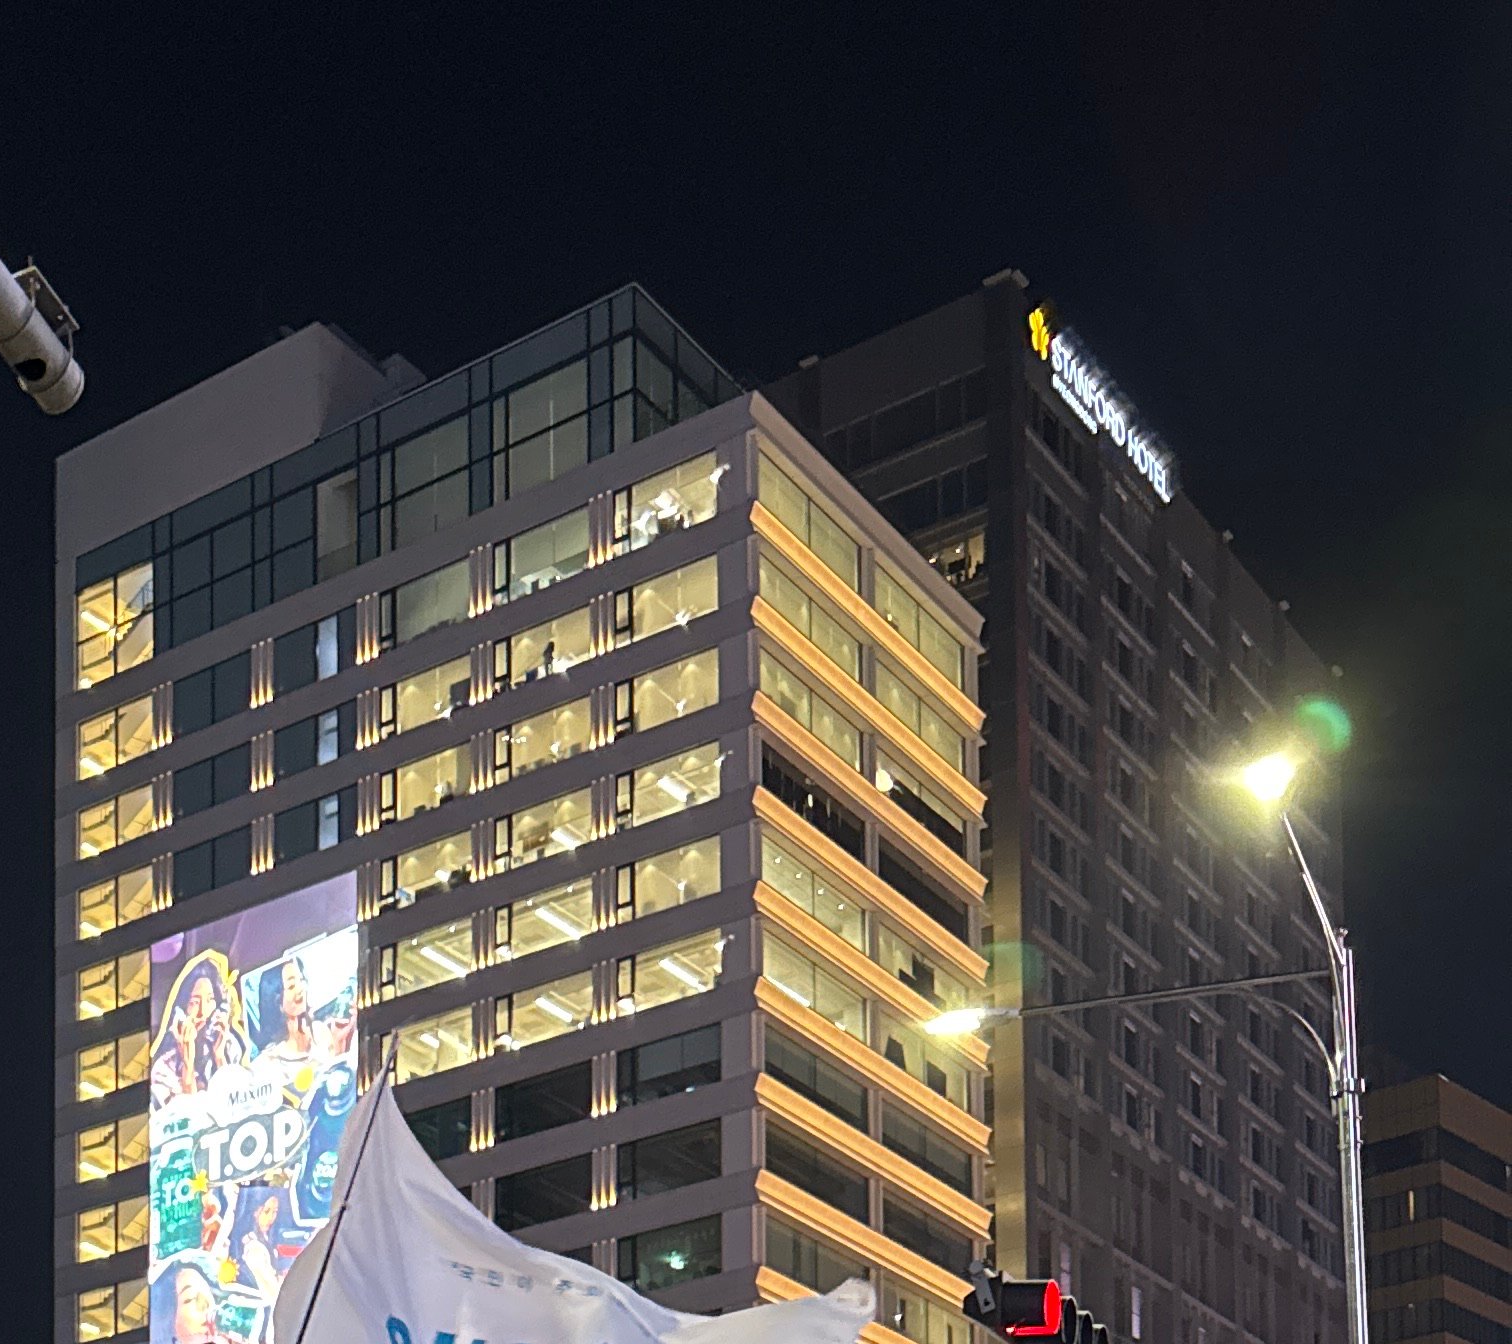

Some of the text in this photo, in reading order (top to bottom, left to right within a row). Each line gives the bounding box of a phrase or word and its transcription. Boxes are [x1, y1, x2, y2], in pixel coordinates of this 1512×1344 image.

[1050, 333, 1126, 448] STANFORD
[1127, 429, 1171, 504] HOTEL
[227, 1083, 273, 1107] Maxim
[199, 1109, 304, 1183] T.O.P
